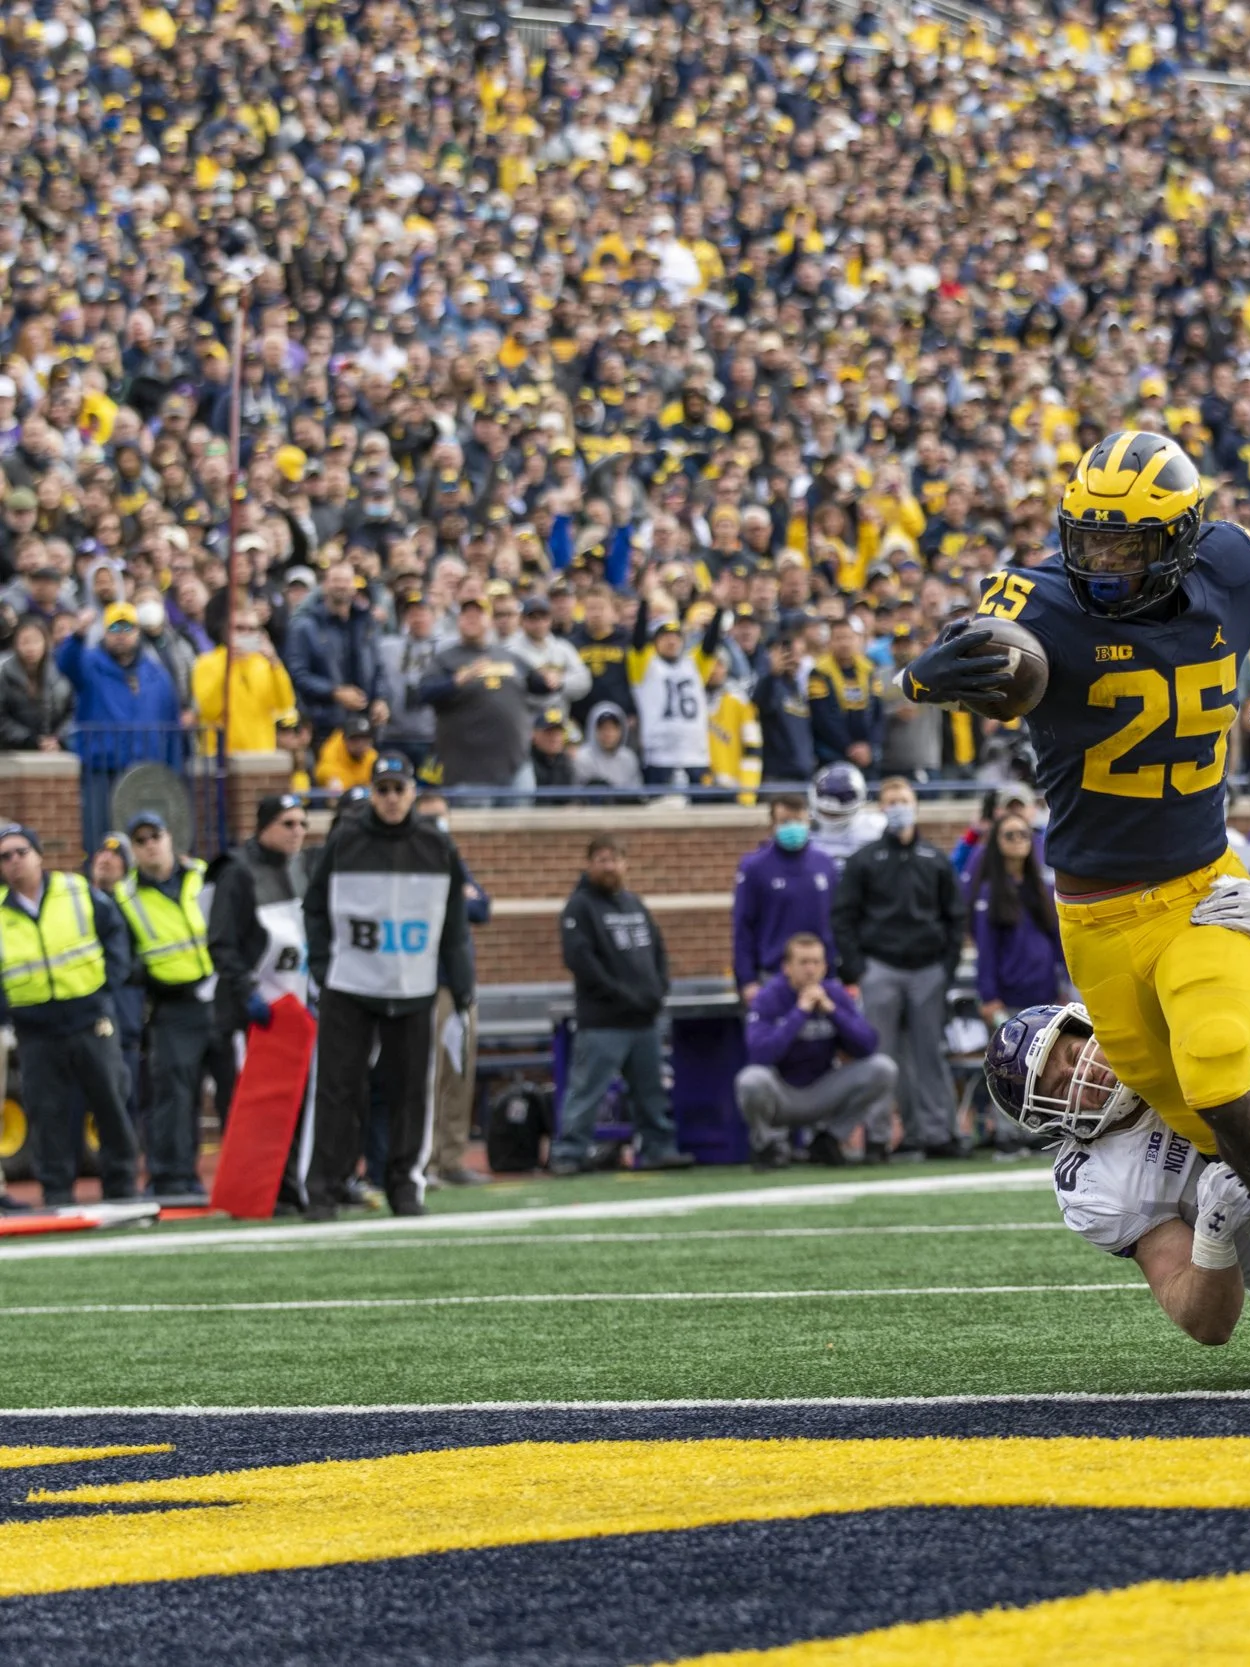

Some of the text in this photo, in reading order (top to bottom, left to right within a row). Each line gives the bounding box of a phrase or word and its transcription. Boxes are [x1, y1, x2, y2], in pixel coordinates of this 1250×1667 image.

[1095, 510, 1109, 522] M
[978, 570, 1036, 621] 25
[663, 677, 698, 720] 16
[1081, 653, 1238, 799] 25
[1163, 1131, 1191, 1175] NORT
